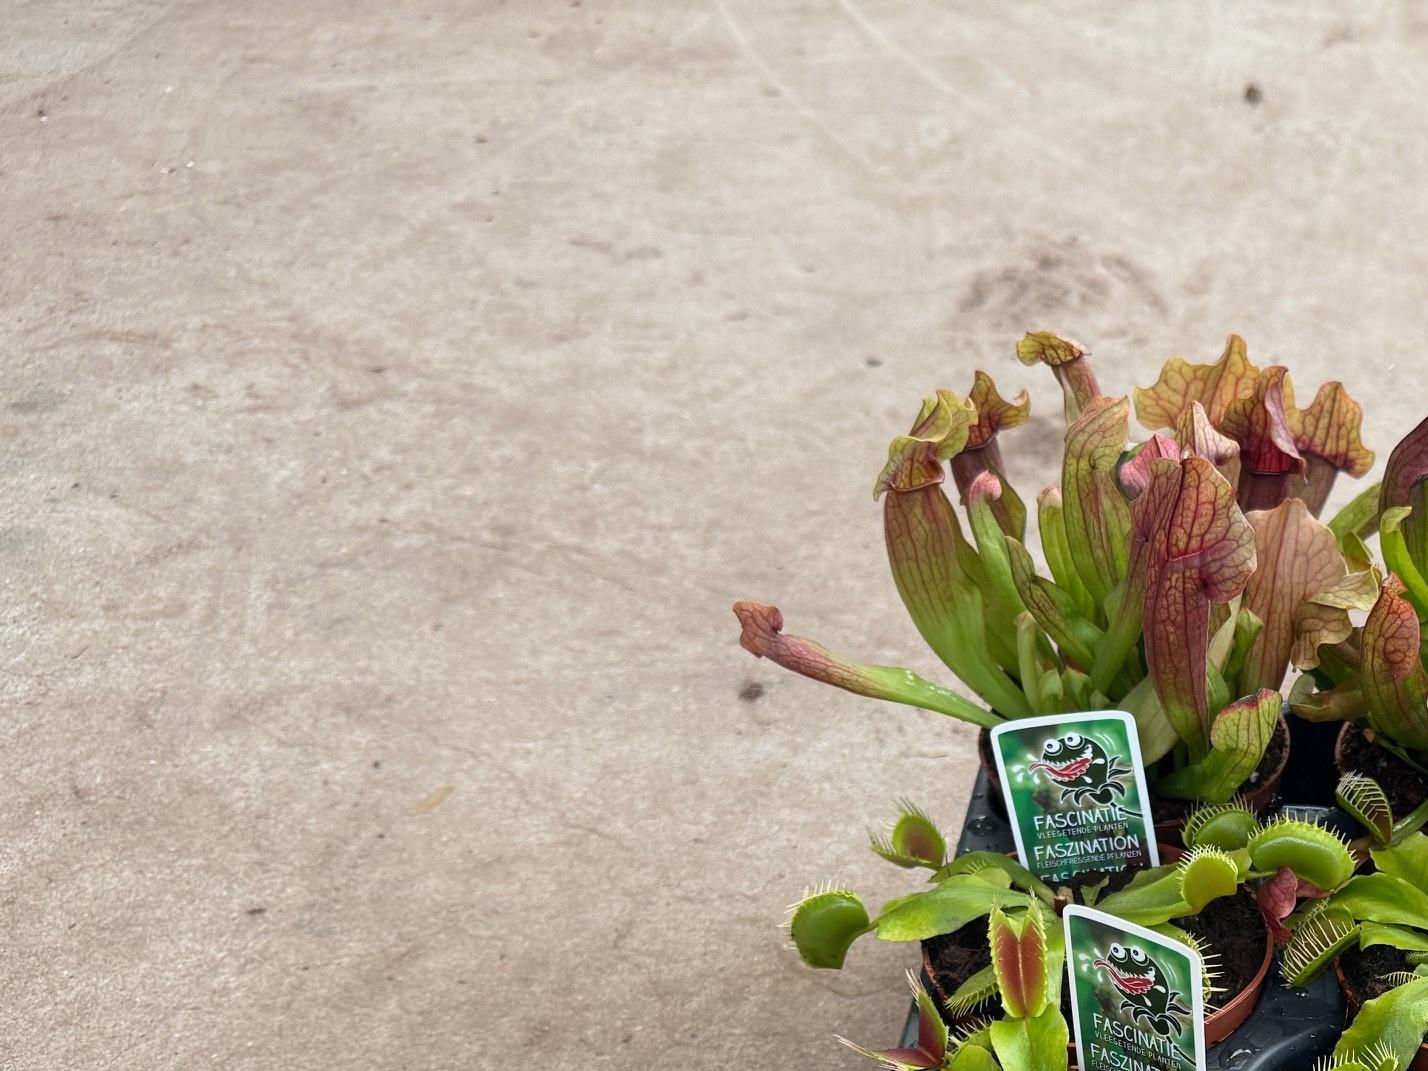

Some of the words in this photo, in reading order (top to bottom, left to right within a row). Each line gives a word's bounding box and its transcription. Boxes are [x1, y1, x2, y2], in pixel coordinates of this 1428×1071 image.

[1033, 805, 1127, 831] FASCINATIE
[1037, 826, 1092, 839] VLEESETENDE
[1094, 821, 1128, 833] PLANTEN
[1033, 834, 1140, 861] FASZINATION
[1093, 1013, 1181, 1060] FASCINATIE
[1095, 1032, 1146, 1058] VLEESETENDE
[1148, 1052, 1181, 1069] PLANTEN
